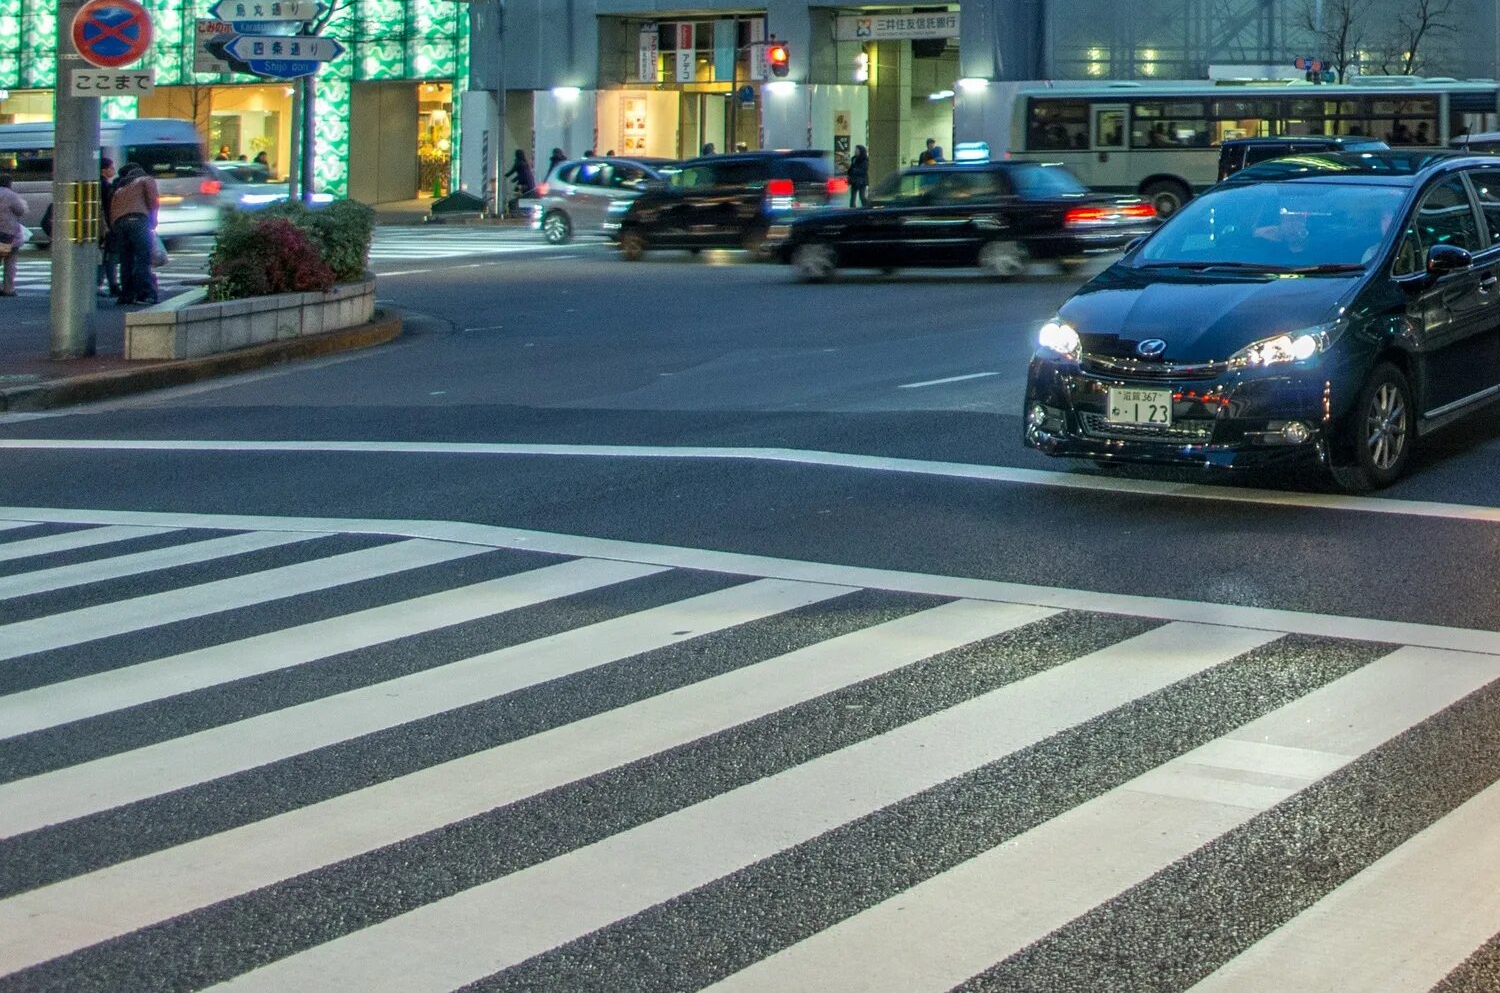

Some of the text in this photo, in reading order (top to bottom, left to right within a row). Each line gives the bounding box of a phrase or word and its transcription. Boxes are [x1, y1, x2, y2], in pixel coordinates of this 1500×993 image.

[236, 1, 299, 17] 烏丸通り
[877, 16, 956, 31] 三井住友信託銀行
[253, 41, 318, 56] 四条通り
[682, 53, 690, 80] アデコ
[76, 74, 150, 91] ここまで
